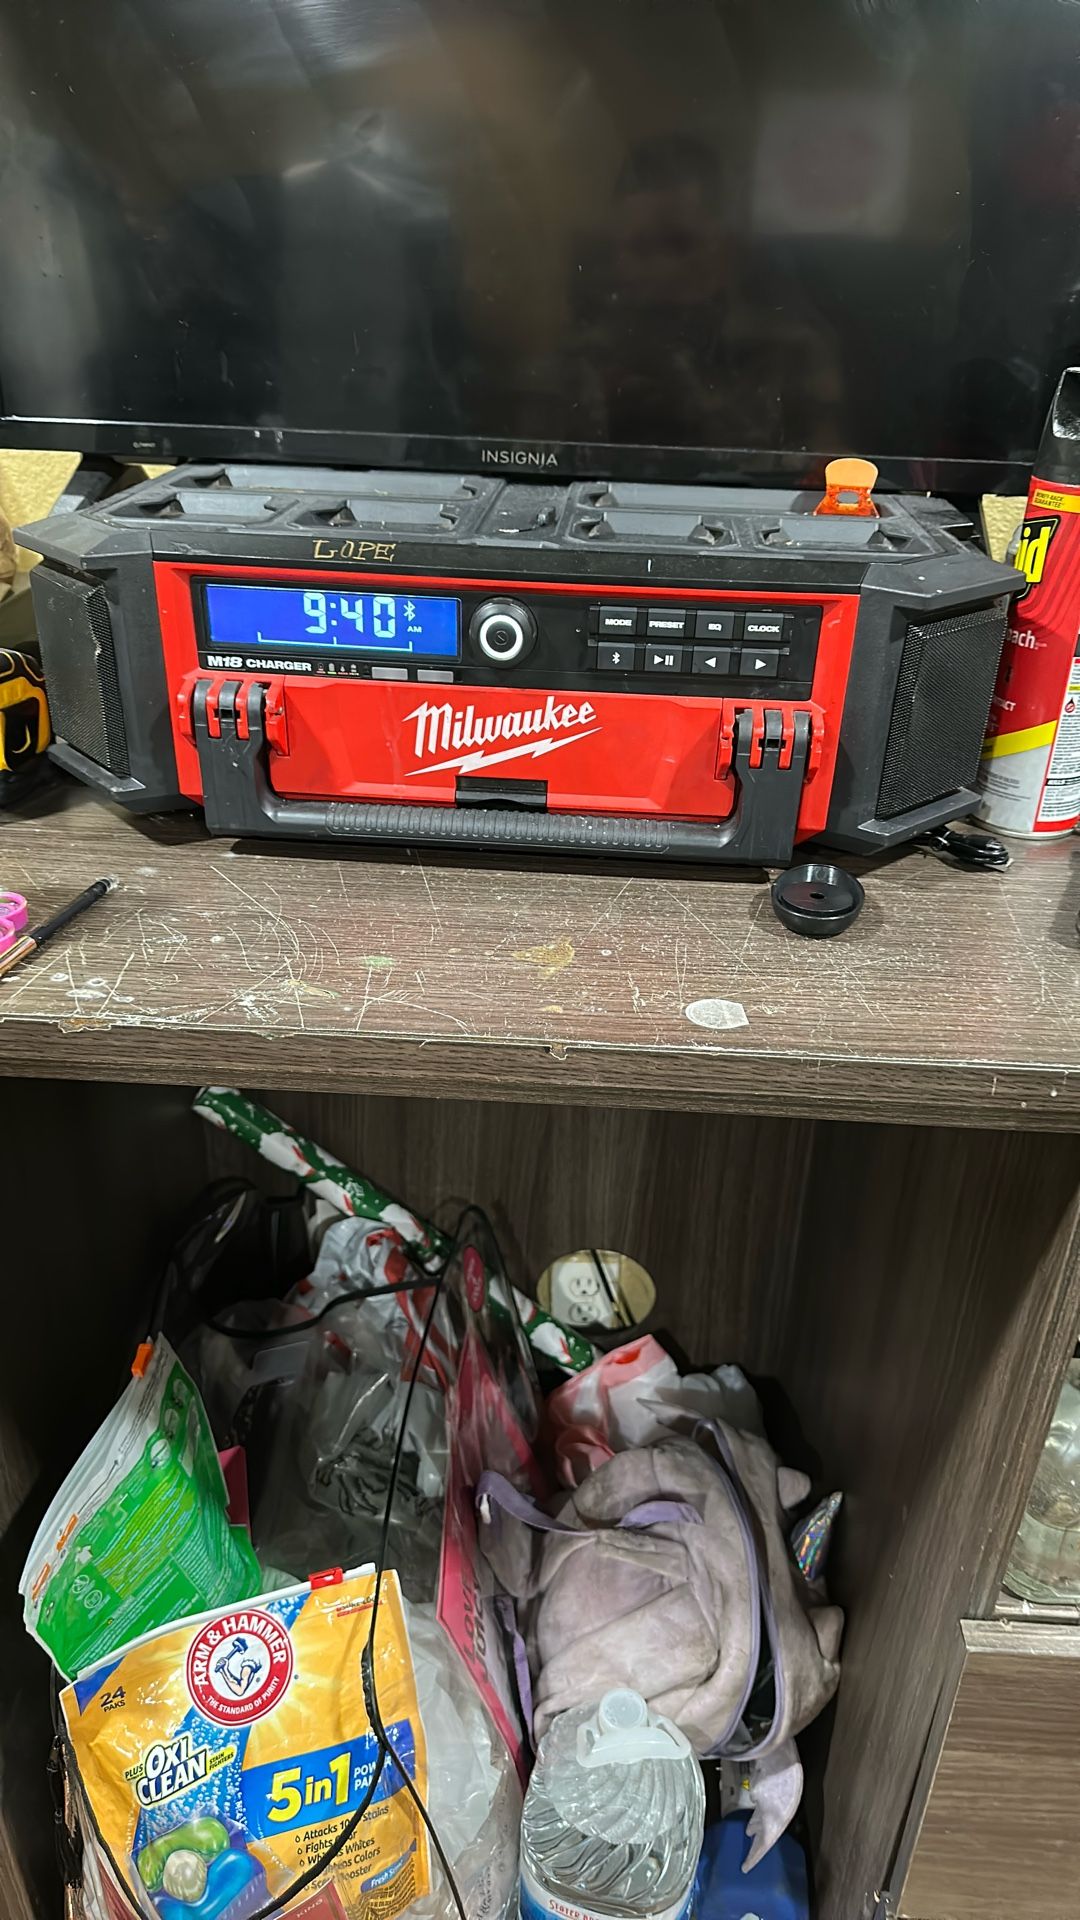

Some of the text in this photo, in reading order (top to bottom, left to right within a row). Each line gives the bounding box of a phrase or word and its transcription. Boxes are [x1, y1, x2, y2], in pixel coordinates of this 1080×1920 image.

[481, 449, 558, 467] INSIGNIA
[312, 539, 396, 562] LOPE
[1014, 526, 1052, 583] id
[303, 592, 396, 638] 9:40
[605, 618, 632, 627] MODE
[407, 625, 422, 633] AM
[649, 620, 685, 630] PRESET
[708, 623, 722, 632] EQ
[747, 625, 780, 634] CLOCK
[206, 655, 312, 671] M18 CHARGER
[401, 696, 597, 758] Milwaukee
[193, 1614, 287, 1686] ARM & HAMMER
[100, 1686, 126, 1708] 24
[207, 1676, 281, 1715] THE STANDARD OF PURITY
[103, 1700, 126, 1712] PAKS
[145, 1735, 190, 1779] OXI
[209, 1752, 225, 1765] STAIN
[209, 1753, 234, 1771] FIGHTERS
[125, 1764, 144, 1779] PLUS
[354, 1755, 392, 1778] POWR
[136, 1750, 207, 1806] CLEAN
[303, 1824, 338, 1842] Attacks
[362, 1805, 389, 1823] Stains
[305, 1838, 333, 1855] Fights
[344, 1837, 375, 1854] Whites
[353, 1846, 381, 1864] Colors
[370, 1872, 389, 1888] Fresh
